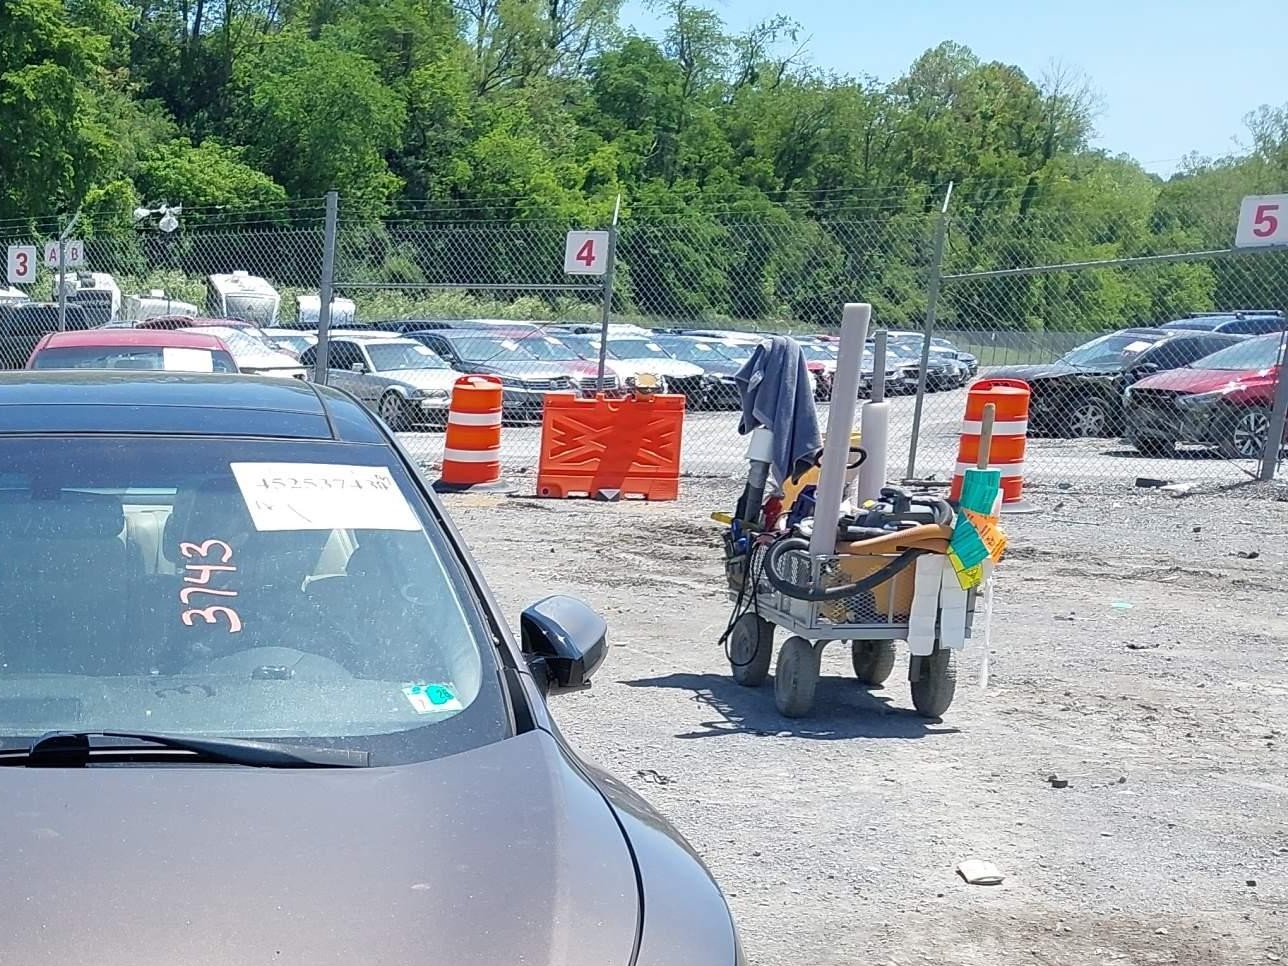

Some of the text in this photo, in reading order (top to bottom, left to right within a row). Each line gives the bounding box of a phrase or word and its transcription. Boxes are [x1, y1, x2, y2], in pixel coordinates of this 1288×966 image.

[1253, 204, 1280, 238] 5
[15, 252, 28, 276] 3
[48, 248, 57, 262] A
[71, 247, 79, 261] B
[575, 239, 596, 267] 4
[179, 539, 242, 633] 3743
